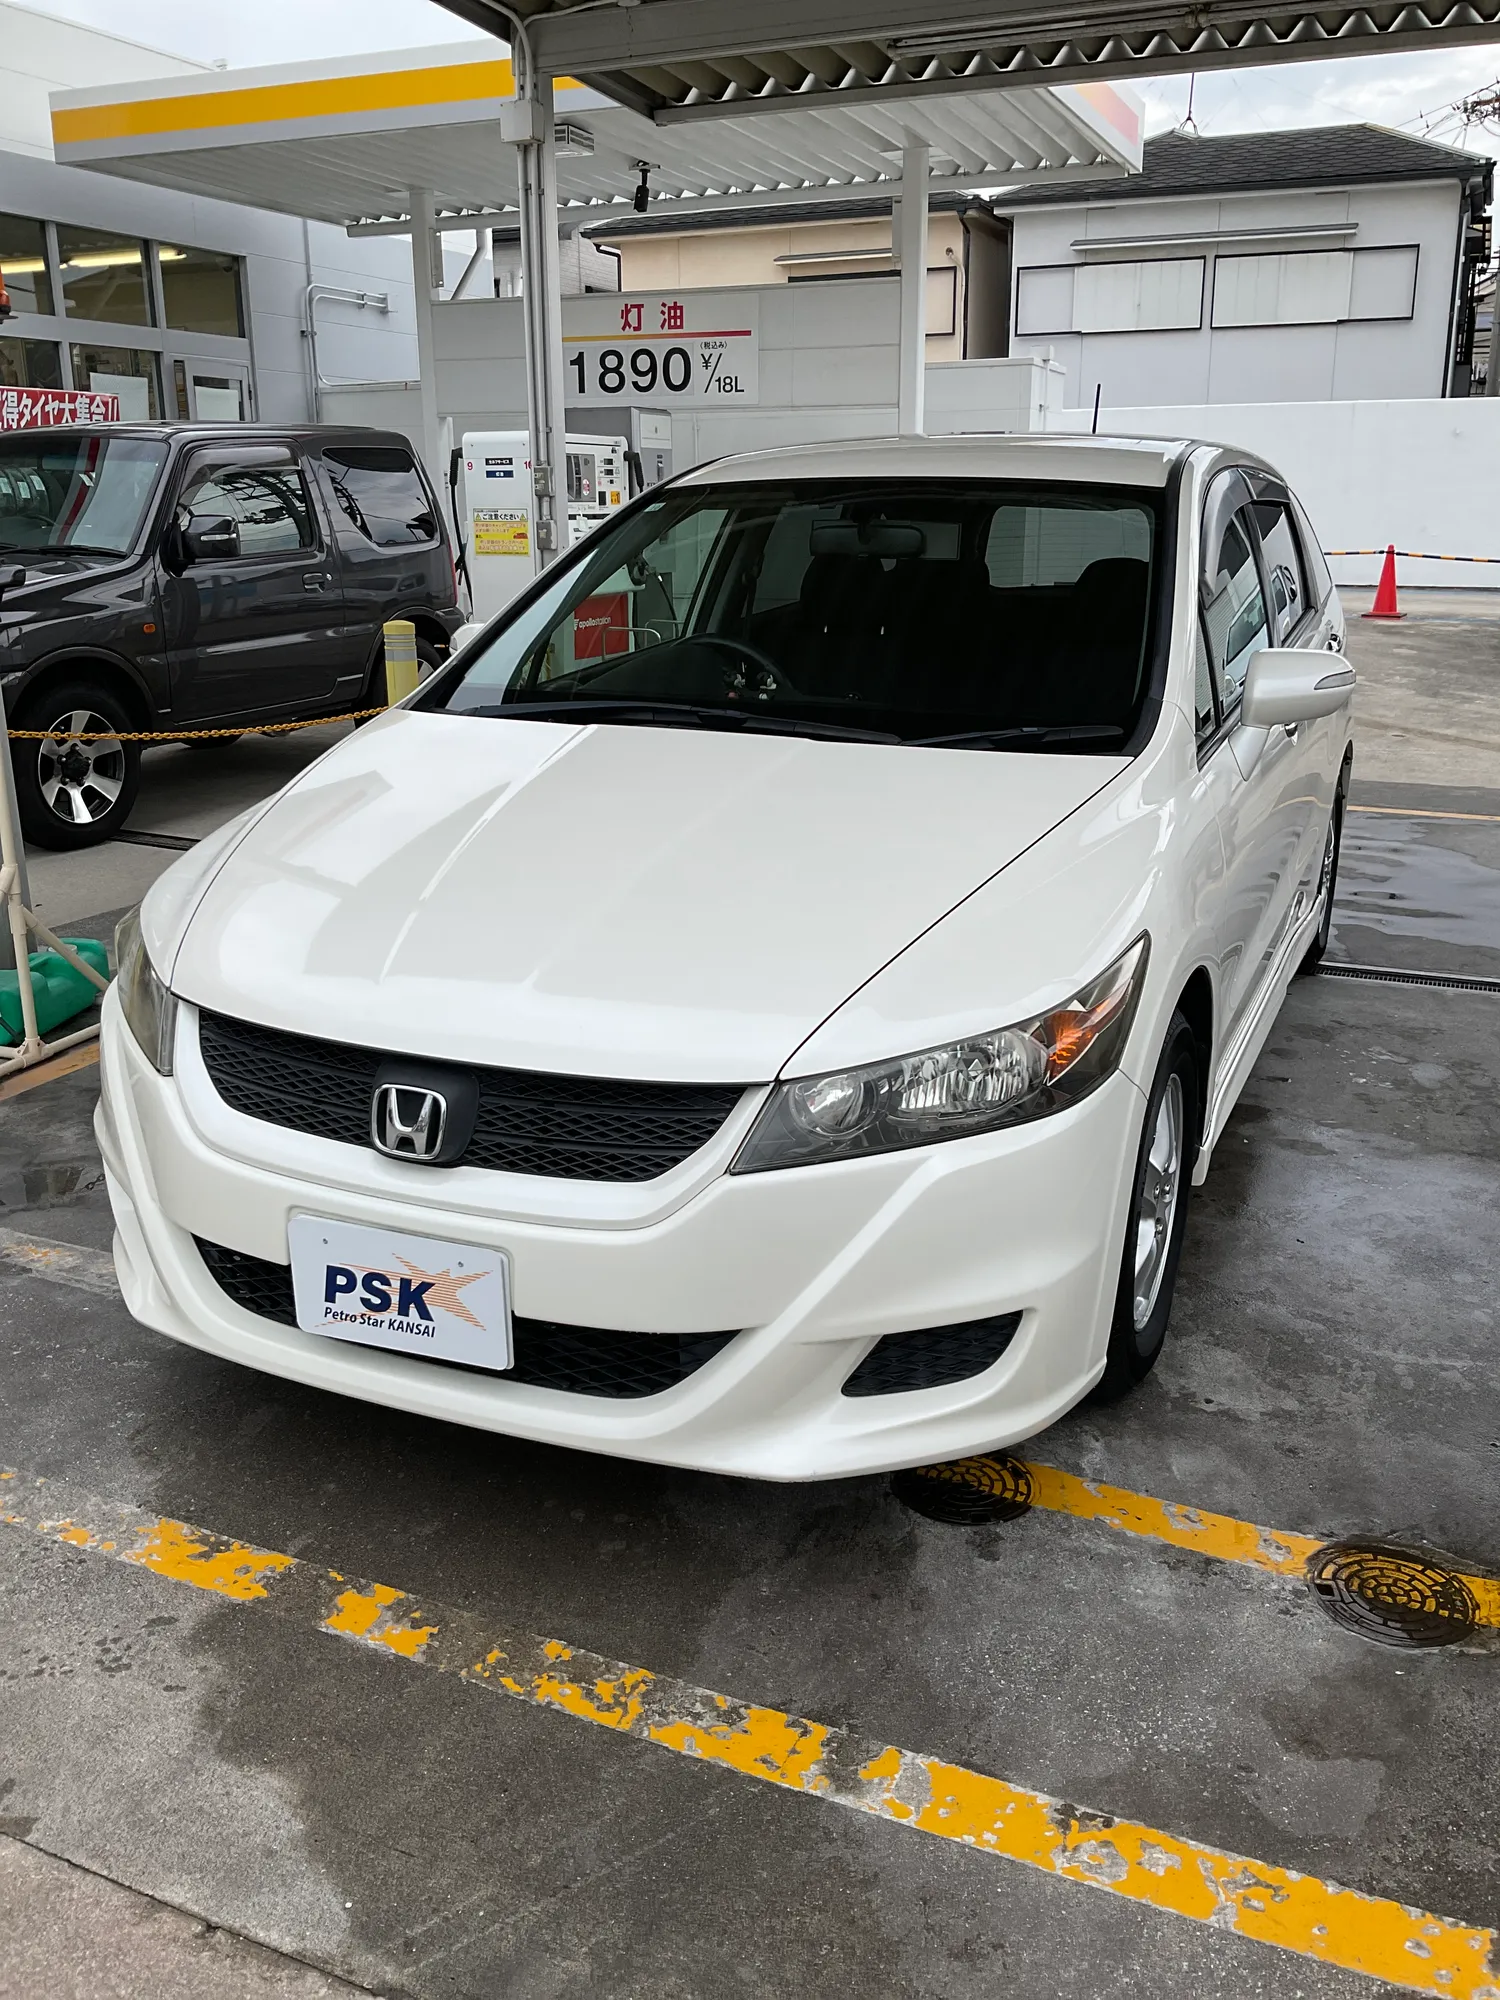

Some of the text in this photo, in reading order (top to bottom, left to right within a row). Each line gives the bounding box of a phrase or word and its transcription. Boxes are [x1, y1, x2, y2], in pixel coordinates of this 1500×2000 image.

[620, 301, 684, 331] 灯油
[569, 347, 692, 394] 1890
[0, 389, 118, 429] 得タイヤ大集合!!
[467, 461, 473, 470] 9
[482, 513, 520, 521] ご注意ください
[579, 616, 611, 630] apollostation
[324, 1264, 436, 1322] PSK
[324, 1307, 436, 1338] Petro Star KANSAI
